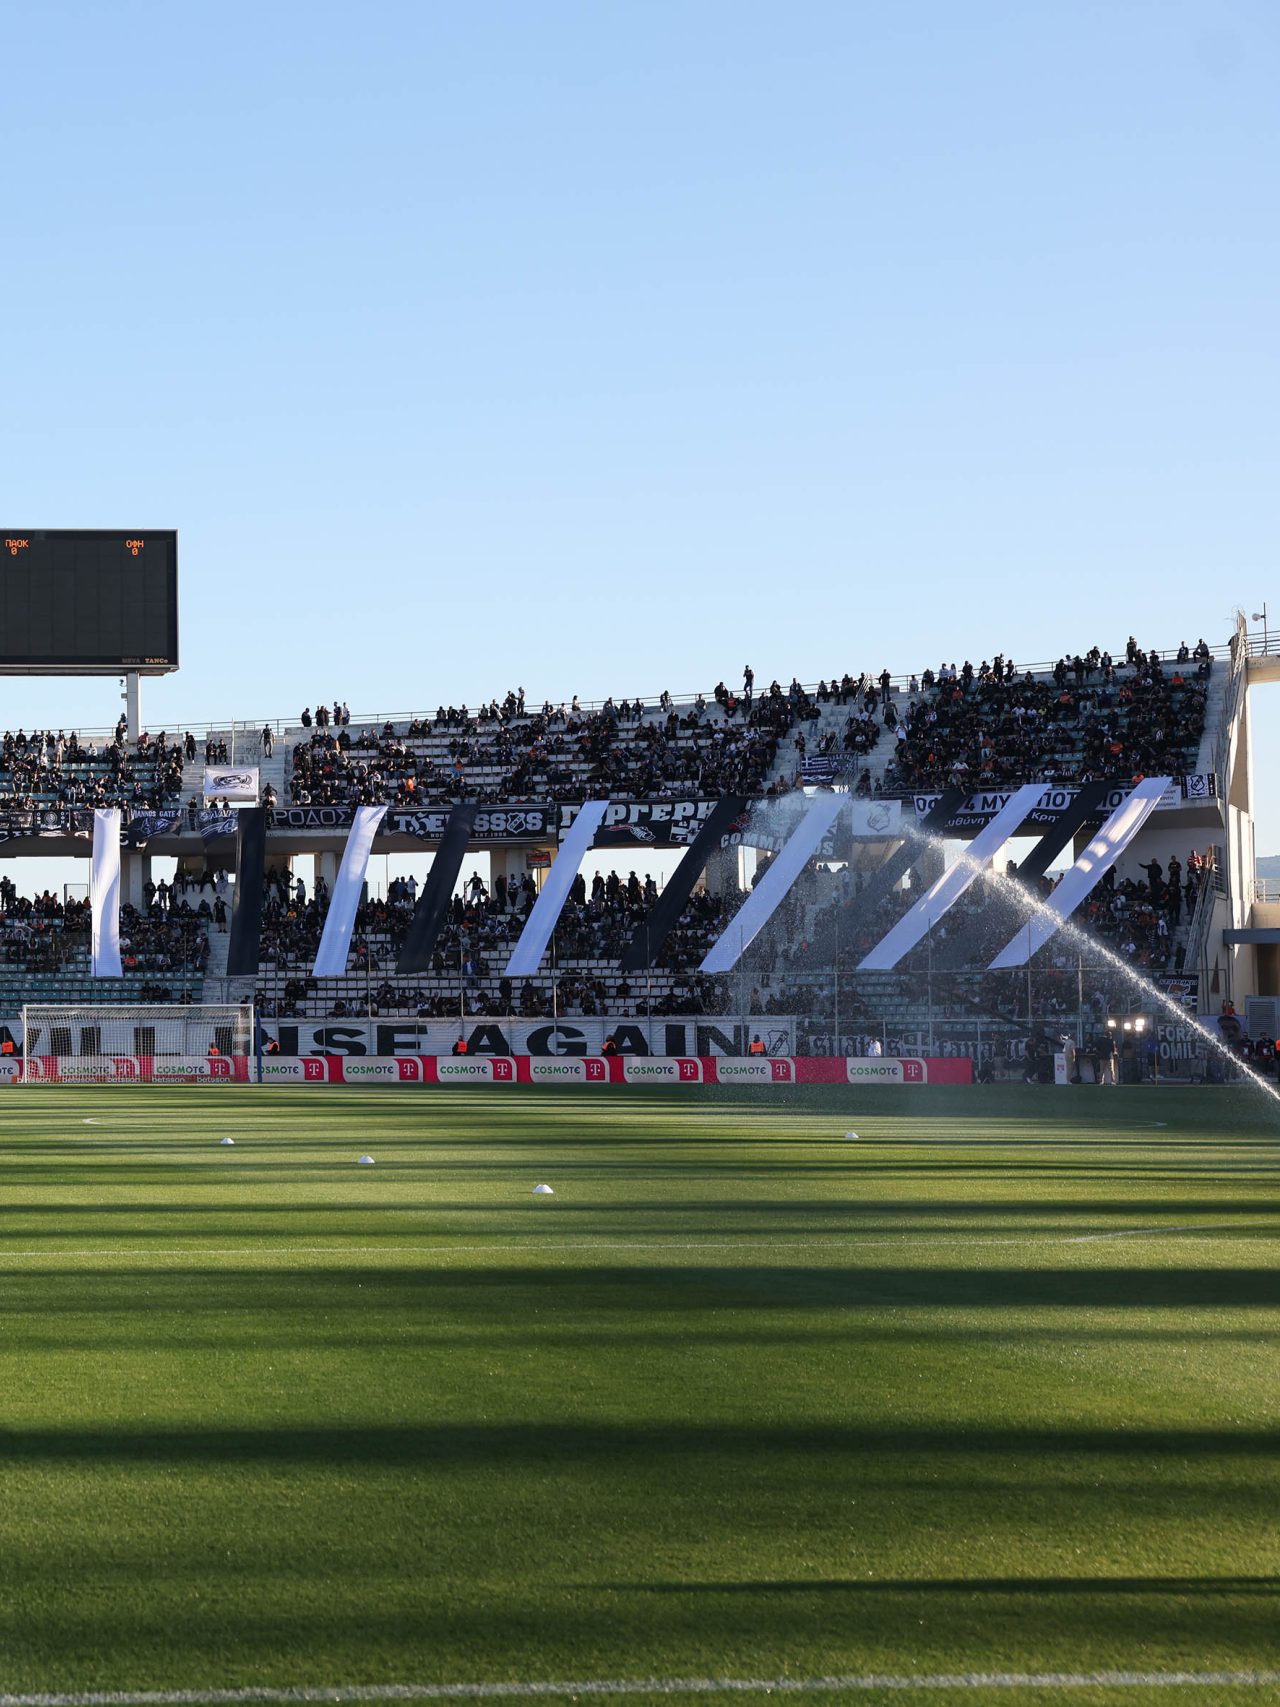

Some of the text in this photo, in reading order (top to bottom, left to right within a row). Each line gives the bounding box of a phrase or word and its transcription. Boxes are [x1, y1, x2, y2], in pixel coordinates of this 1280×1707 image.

[5, 539, 29, 547] ΠΑΟΚ
[126, 540, 144, 548] ΟΦΗ
[11, 547, 18, 555] 0
[131, 548, 138, 556] 0
[272, 809, 352, 825] ΡΟΔΟΣ
[945, 816, 984, 827] υθύνη
[466, 1023, 750, 1057] AGAIN
[157, 1066, 205, 1074] COSMOTE
[346, 1065, 394, 1075] COSMOTE
[440, 1065, 488, 1075] COSMOTE
[533, 1065, 580, 1075] COSMOTE
[626, 1065, 674, 1075] COSMOTE
[720, 1065, 767, 1075] COSMOTE
[850, 1066, 898, 1076] COSMOTE
